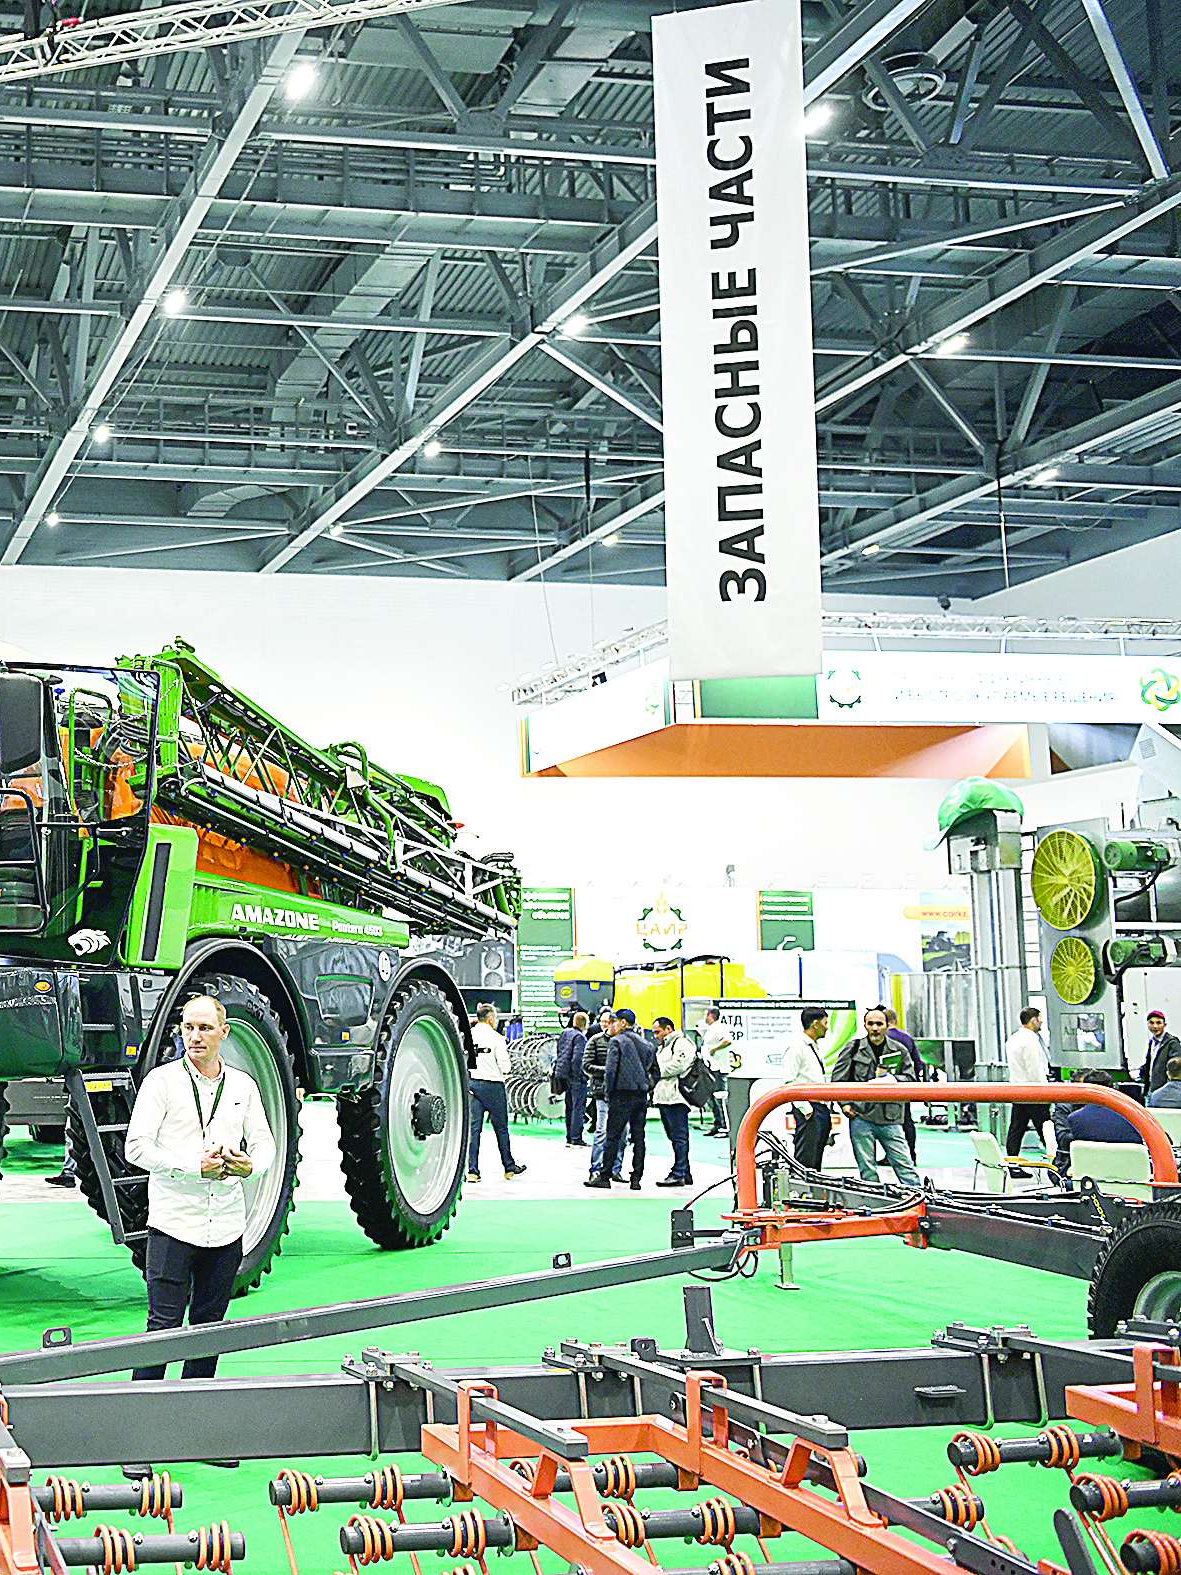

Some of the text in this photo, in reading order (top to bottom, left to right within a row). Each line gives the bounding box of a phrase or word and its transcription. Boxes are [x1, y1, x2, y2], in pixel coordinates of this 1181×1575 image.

[704, 57, 767, 603] ЗАПАСНЫЕ ЧАСТИ
[231, 903, 320, 931] AMAZONE
[331, 920, 362, 935] Pantera
[637, 923, 688, 937] ЦАИР
[721, 1015, 743, 1027] АТД
[728, 1030, 744, 1041] ЗР
